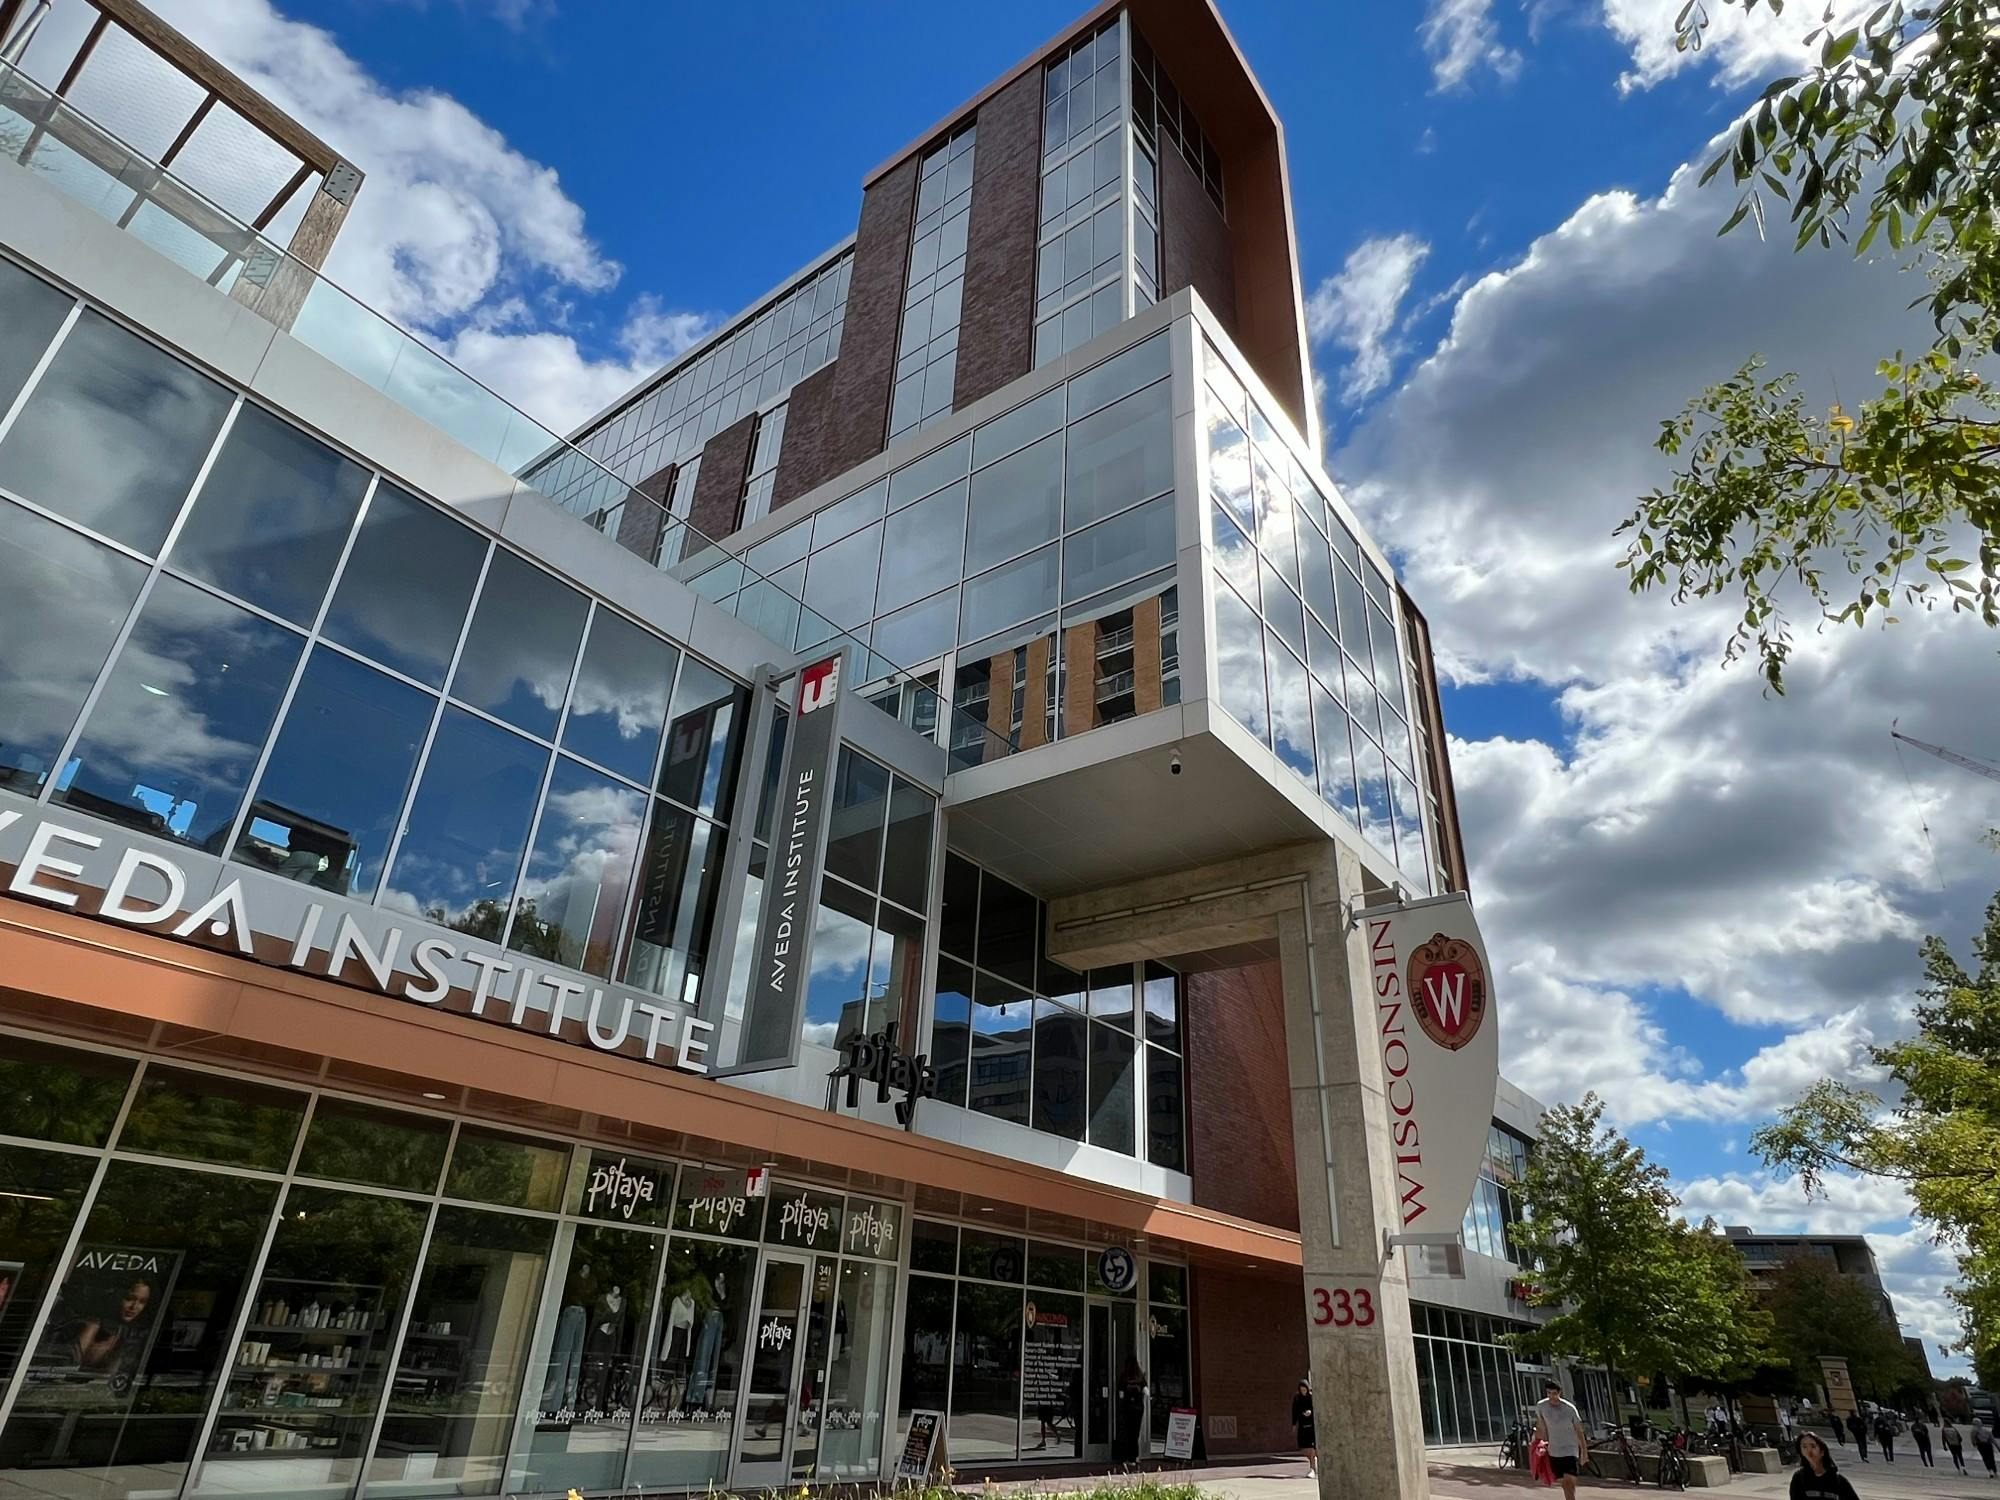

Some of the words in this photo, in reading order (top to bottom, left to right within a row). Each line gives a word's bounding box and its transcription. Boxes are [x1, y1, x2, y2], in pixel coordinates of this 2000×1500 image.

[769, 902, 796, 992] AVEDA
[783, 768, 814, 897] INSTITUTE
[291, 904, 716, 1073] INSTITUTE
[1423, 972, 1466, 1028] W
[1369, 919, 1428, 1227] WISCONSIN
[588, 1158, 654, 1218] pitaya
[780, 1192, 829, 1245] pitaya
[850, 1205, 894, 1255] pitaya
[76, 1251, 158, 1273] AVEDA
[818, 1265, 832, 1277] 341
[760, 1317, 792, 1350] pitaya
[1313, 1287, 1376, 1327] 333
